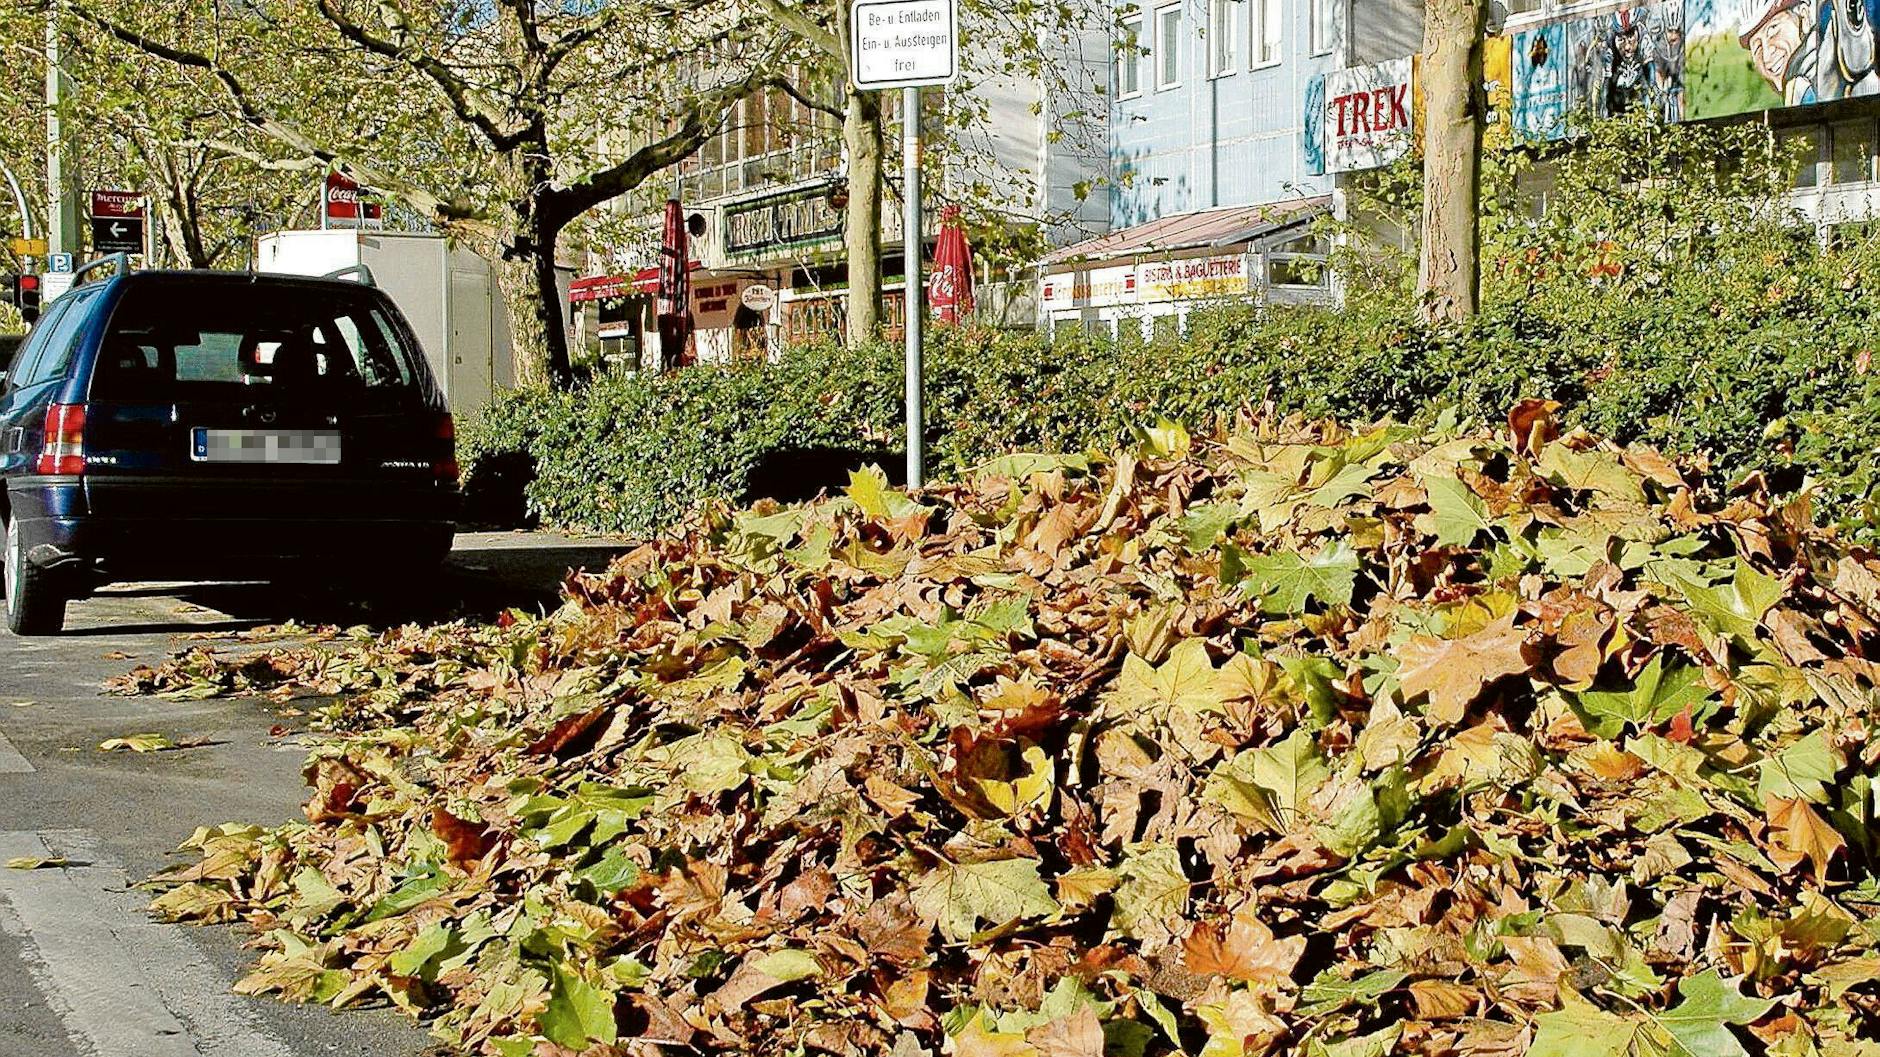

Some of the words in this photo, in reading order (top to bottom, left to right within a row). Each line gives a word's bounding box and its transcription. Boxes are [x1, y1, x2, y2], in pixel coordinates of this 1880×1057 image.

[899, 9, 940, 24] Entladen
[894, 34, 948, 49] Aussteigen
[894, 58, 916, 72] frei
[1334, 82, 1408, 137] TREK
[1175, 264, 1183, 281] &
[1184, 258, 1241, 280] BAGUETTERIE
